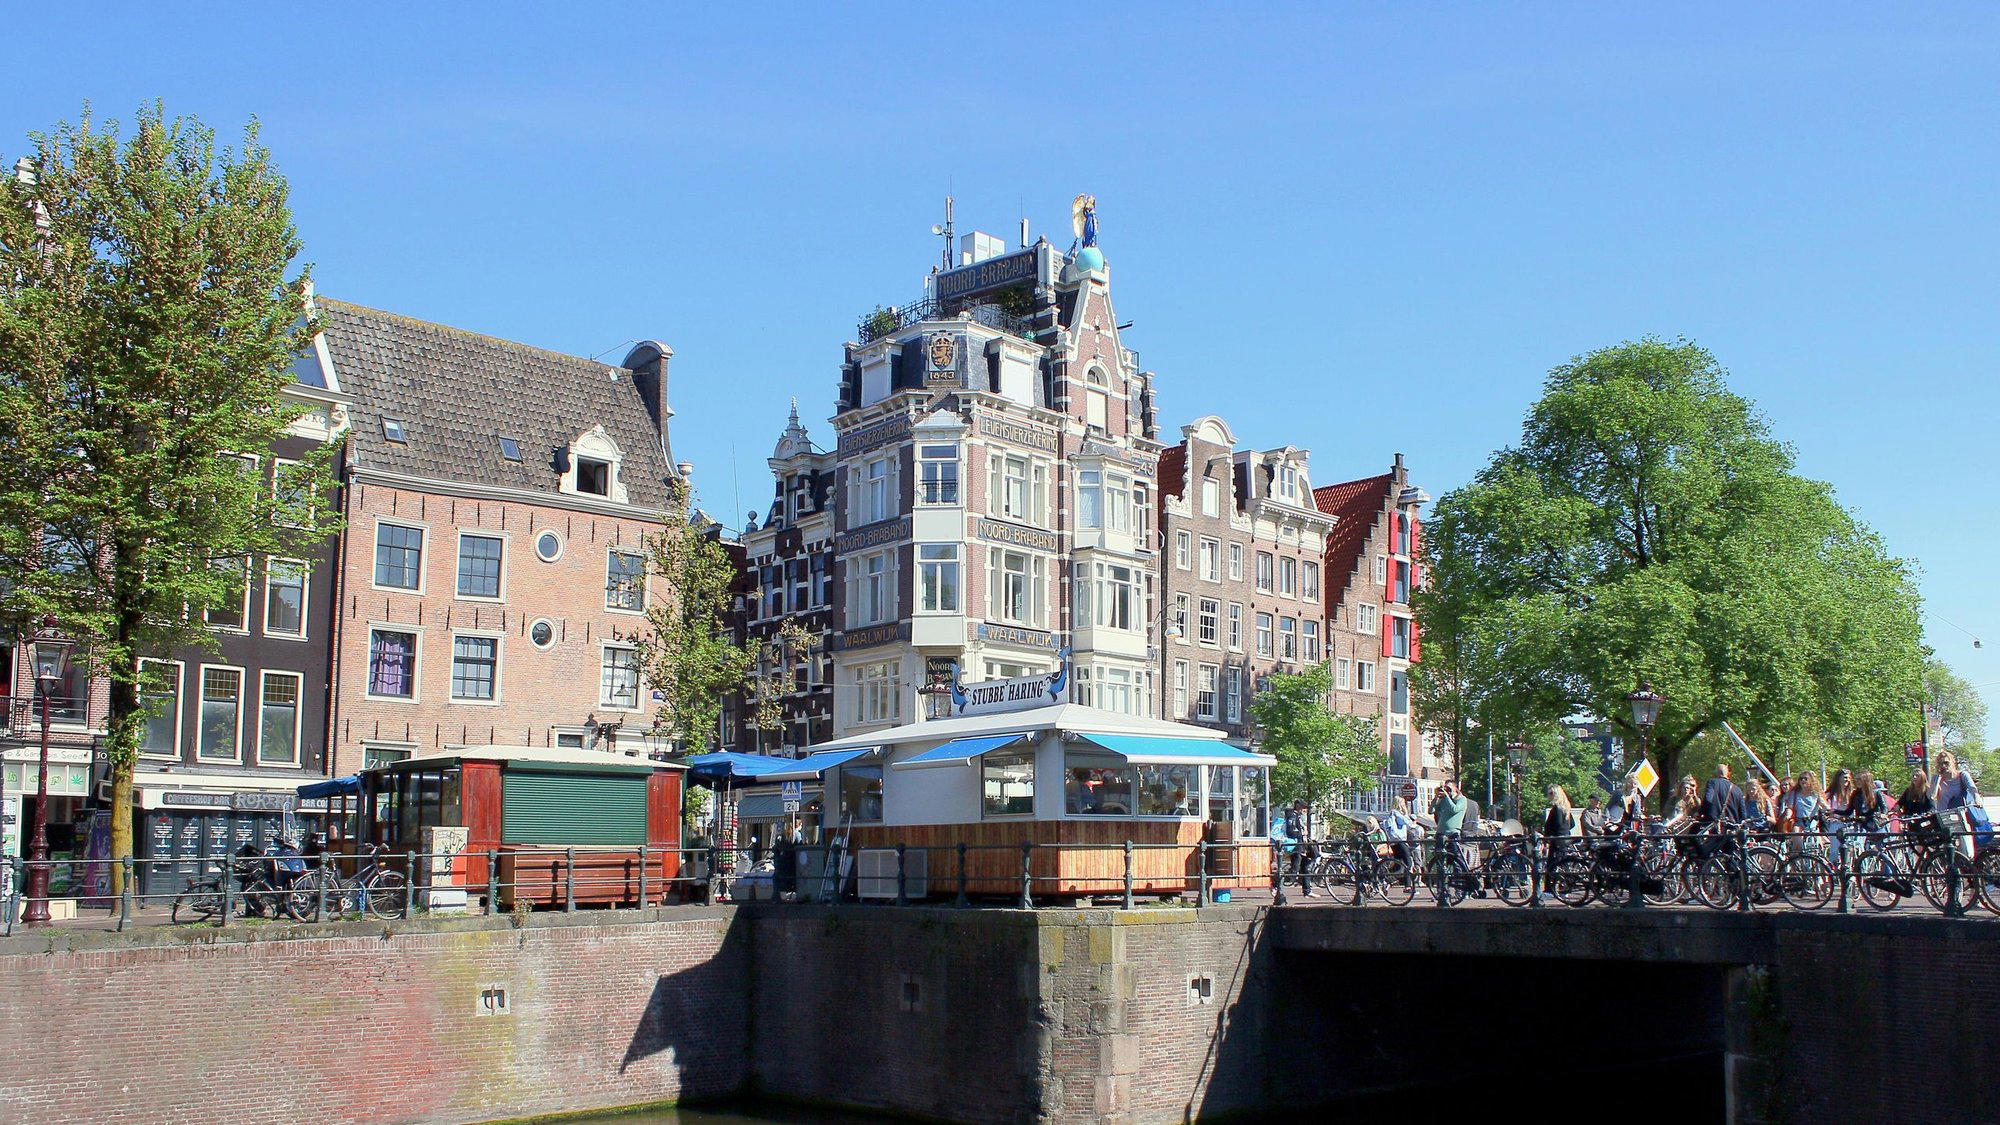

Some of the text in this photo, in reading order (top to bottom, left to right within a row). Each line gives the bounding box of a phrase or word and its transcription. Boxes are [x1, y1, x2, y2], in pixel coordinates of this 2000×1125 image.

[929, 371, 955, 380] 1843
[980, 418, 1058, 453] LEVENSVERZEKERING
[839, 522, 908, 554] NOORD-BRABAND
[979, 520, 1056, 550] NOORD-BRABAND
[844, 623, 899, 648] WAALWIJK
[986, 625, 1055, 648] WAALWIJK
[928, 661, 951, 671] NOOR
[1008, 681, 1044, 701] HARING
[214, 795, 230, 805] BAR
[301, 799, 316, 808] BAR
